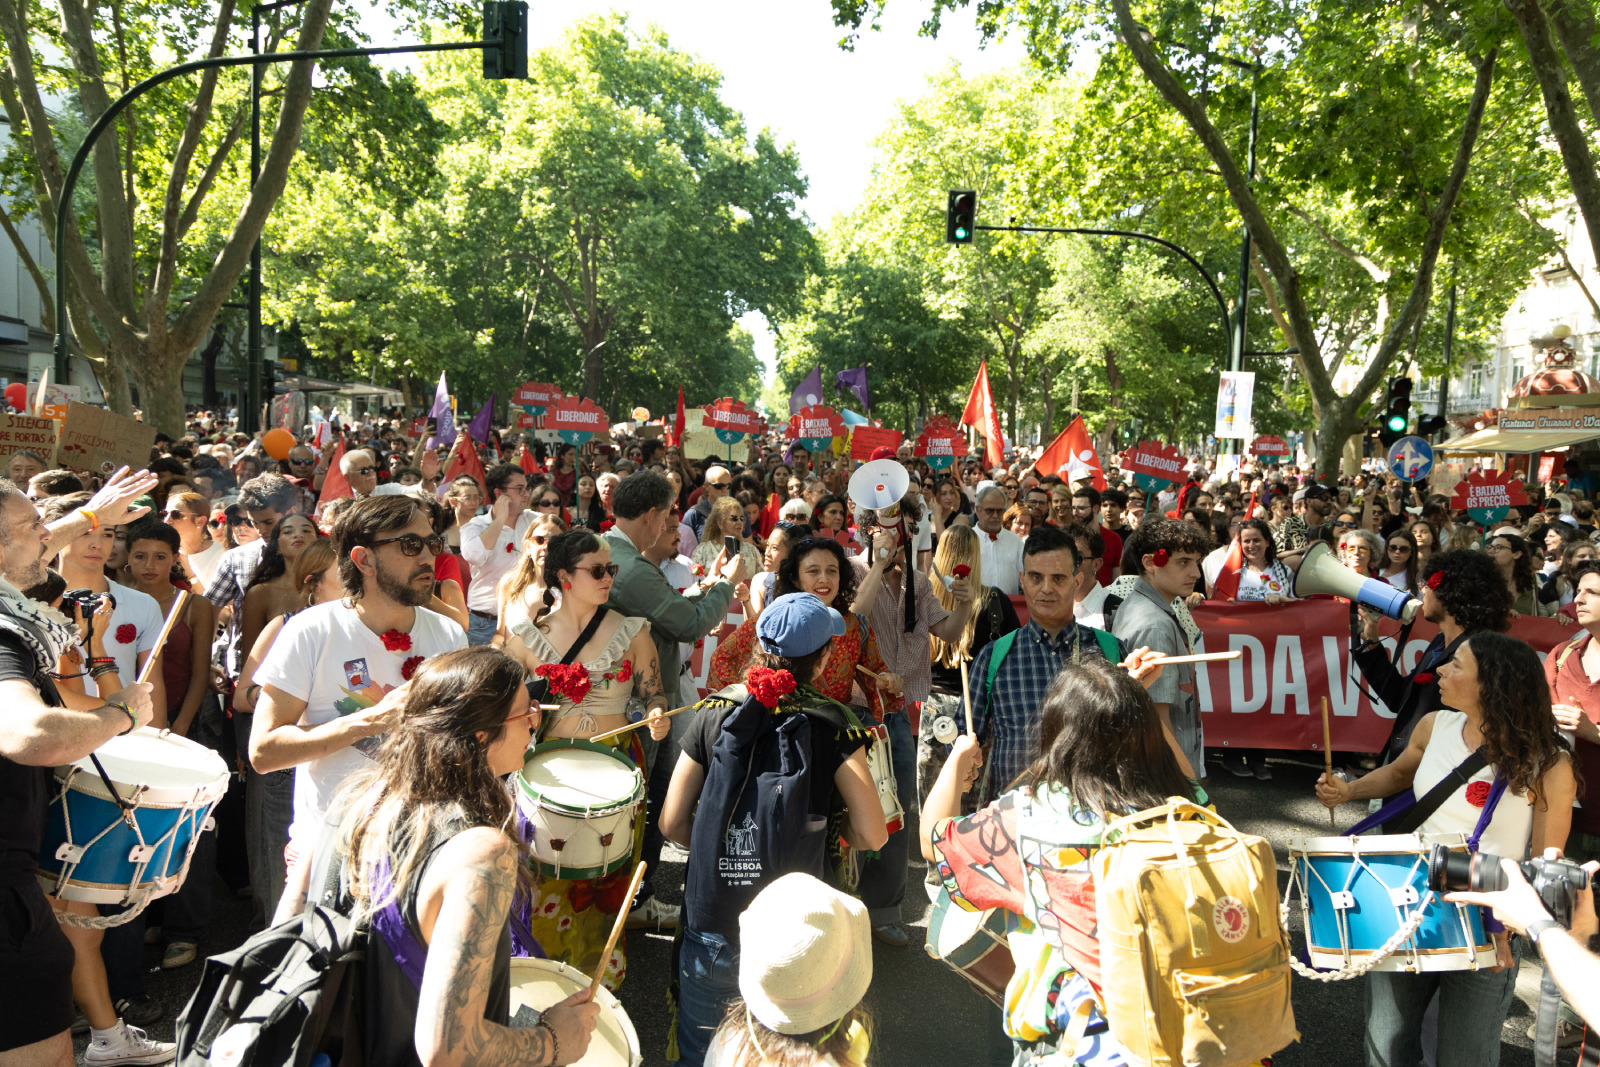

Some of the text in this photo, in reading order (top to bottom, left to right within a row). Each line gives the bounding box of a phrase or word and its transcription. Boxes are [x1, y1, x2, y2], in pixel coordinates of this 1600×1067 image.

[520, 391, 549, 402] LIBERDADE
[556, 410, 599, 424] LIBERDADE
[712, 409, 751, 426] LIBERDADE
[800, 417, 829, 429] É BAIXAR
[1538, 416, 1572, 428] Churros
[1574, 419, 1580, 428] e
[15, 432, 46, 443] PORTAS
[799, 427, 832, 439] OS PREÇOS
[68, 430, 116, 451] FASCISMO
[932, 438, 951, 447] PARAR
[931, 446, 953, 455] GUERRA
[1256, 443, 1284, 451] LIBERDADE
[1135, 452, 1181, 473] LIBERDADE
[1469, 484, 1506, 497] É BAIXAR
[1466, 495, 1511, 509] OS PREÇOS
[1229, 634, 1310, 716] DA
[729, 862, 762, 870] LISBOA
